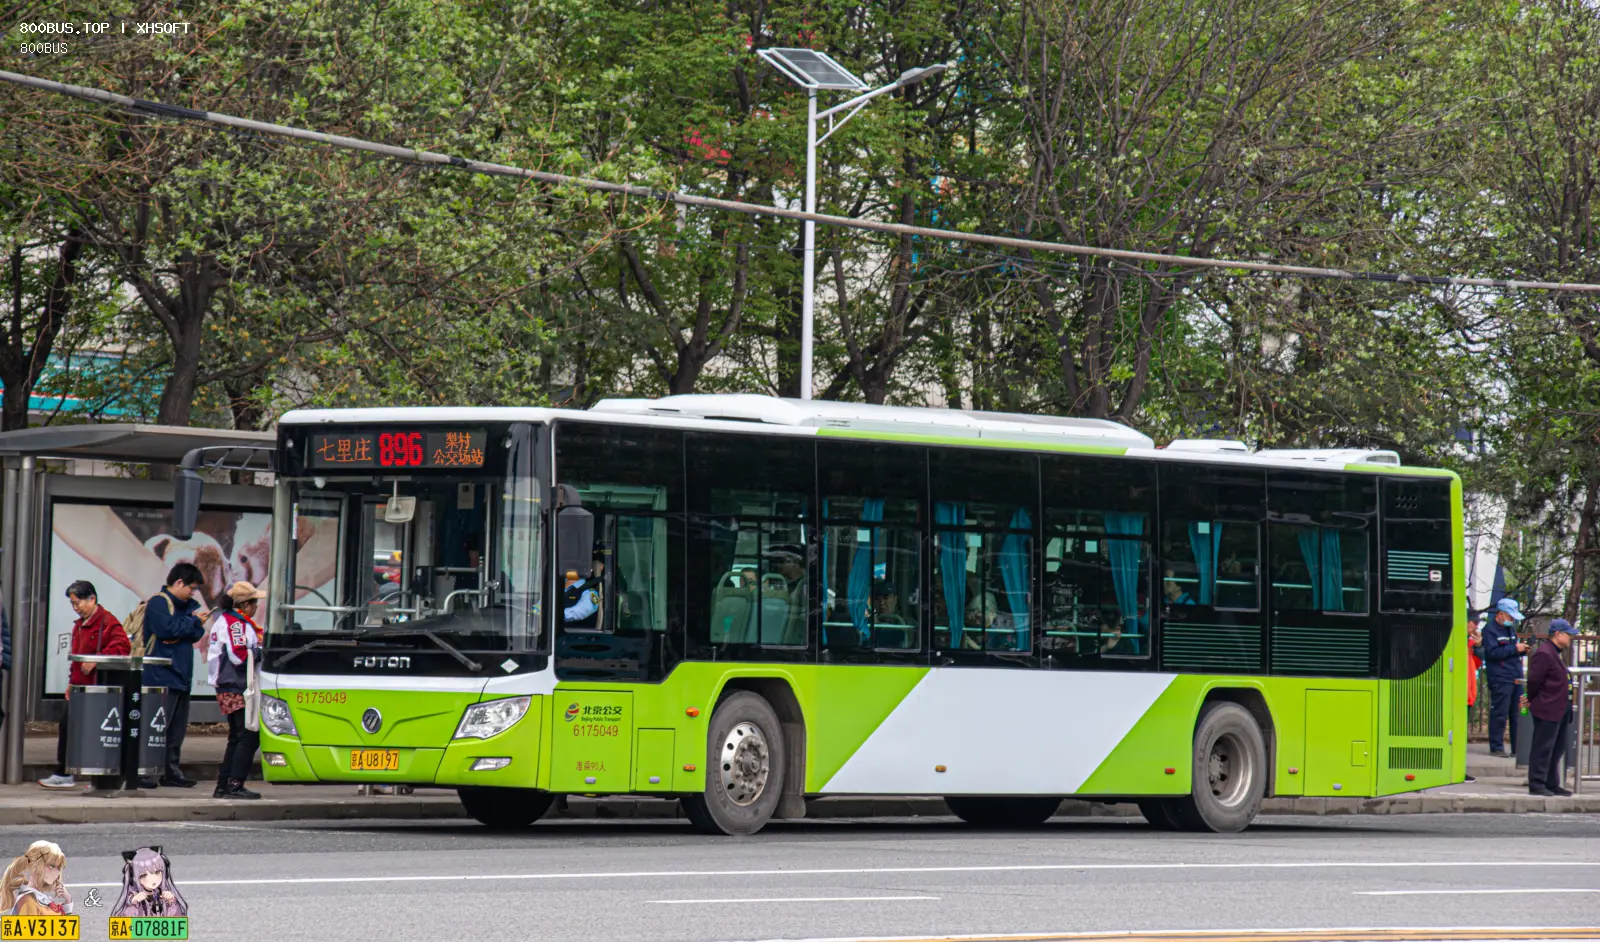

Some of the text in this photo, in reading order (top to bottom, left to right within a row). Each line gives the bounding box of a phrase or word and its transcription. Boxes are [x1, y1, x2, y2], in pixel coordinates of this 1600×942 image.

[316, 437, 372, 462] 七里庄
[378, 432, 424, 467] 896
[433, 449, 485, 466] 公交场站
[353, 656, 411, 668] FOTON
[296, 691, 347, 704] 6175049
[582, 705, 622, 715] 北京公交
[573, 724, 619, 737] 6175049
